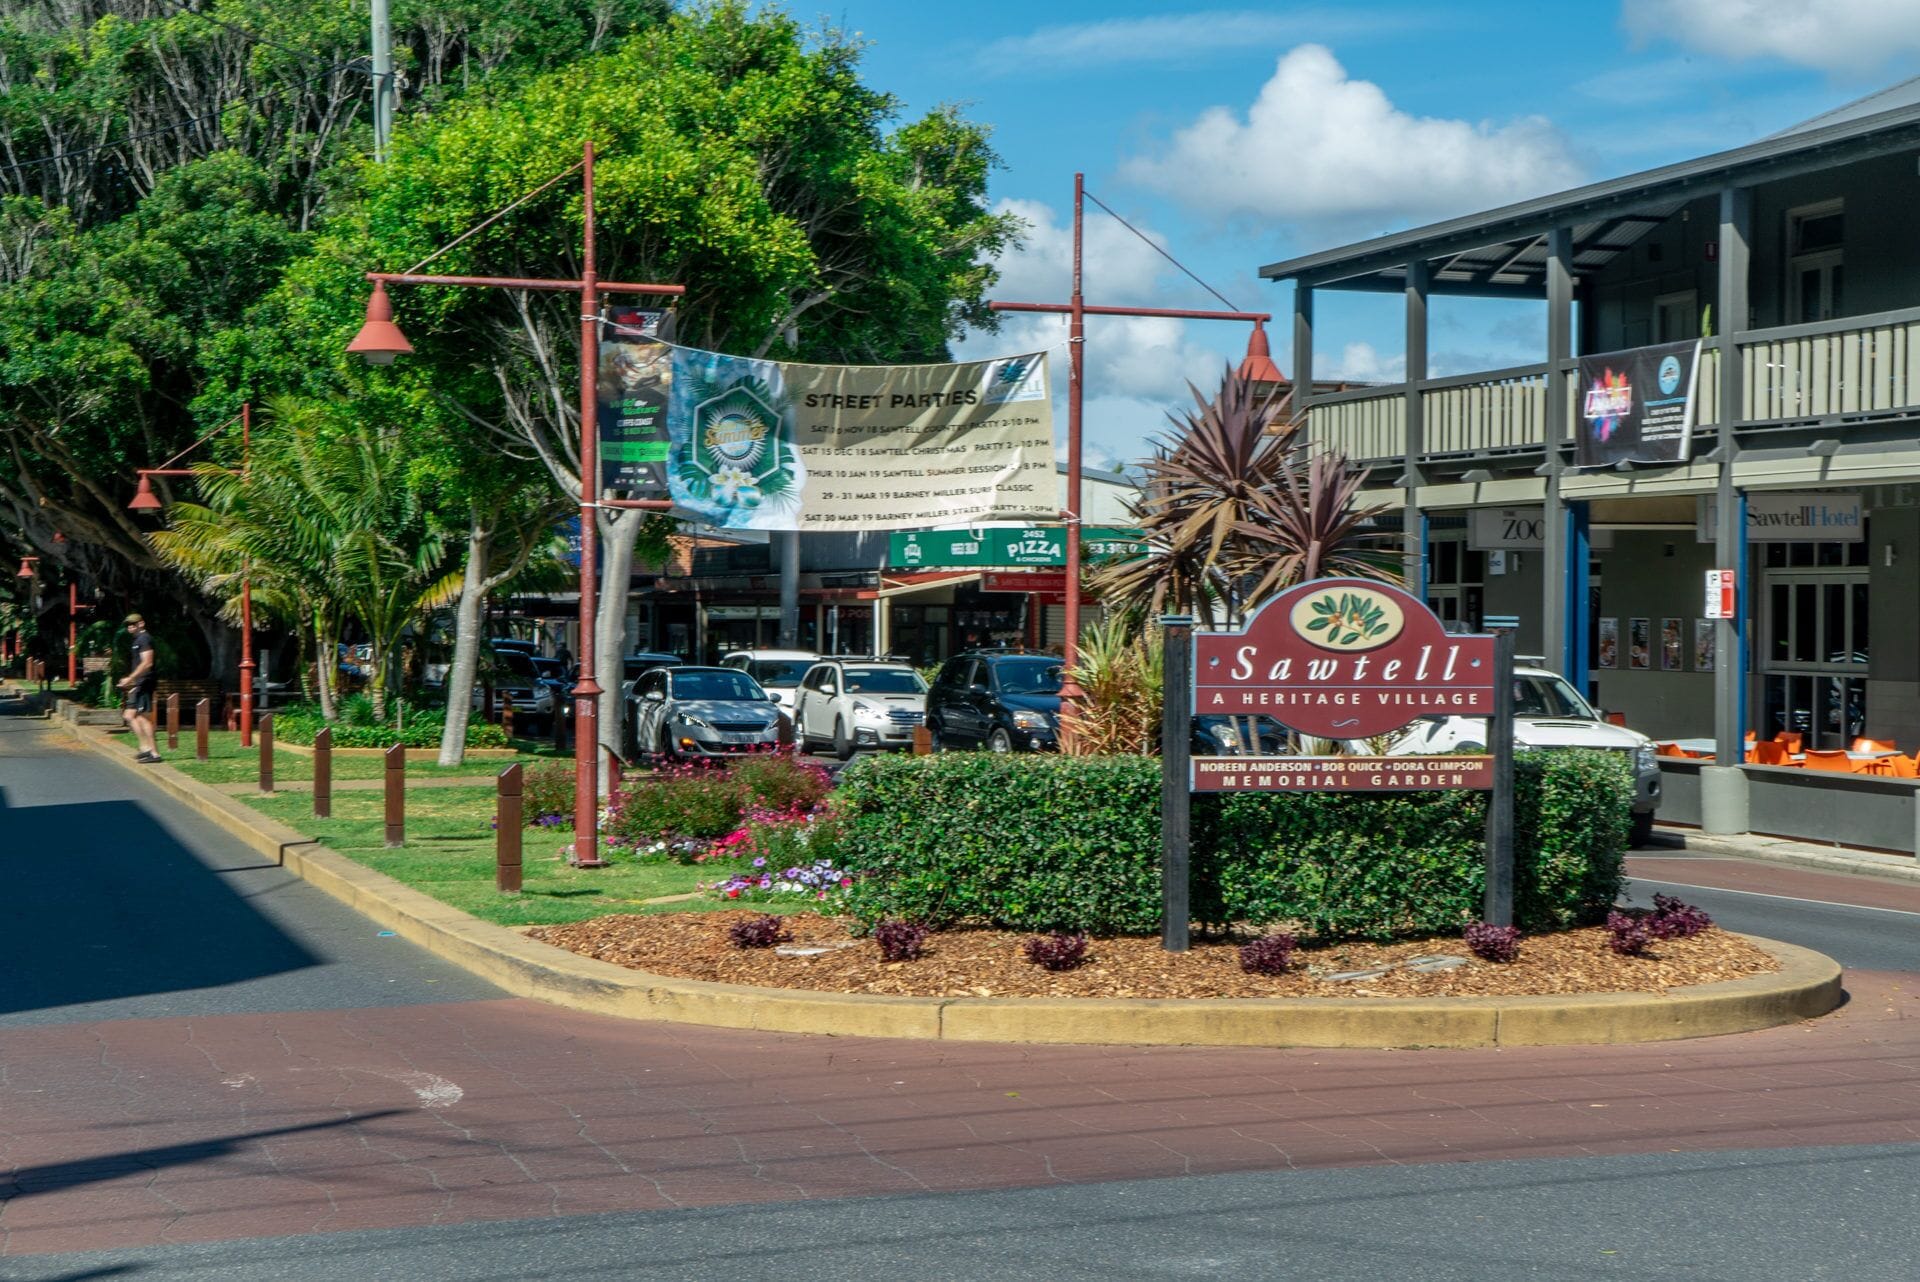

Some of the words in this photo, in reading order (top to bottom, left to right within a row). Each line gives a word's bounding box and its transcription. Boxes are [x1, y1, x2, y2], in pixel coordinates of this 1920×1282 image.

[805, 392, 883, 409] STREET
[890, 388, 977, 408] PARTIES
[811, 424, 829, 433] SAT
[845, 425, 863, 433] NOV
[867, 425, 878, 433] 18
[880, 424, 921, 434] SAWTELL
[970, 420, 999, 430] PARTY
[1002, 417, 1022, 427] 2-10
[1025, 417, 1040, 425] PM
[801, 447, 818, 455] SAT
[821, 447, 831, 456] 15
[834, 447, 853, 456] DEC
[856, 447, 866, 456] 18
[869, 447, 910, 456] SAWTELL
[975, 442, 1004, 452] PARTY
[1007, 441, 1013, 449] 2
[1021, 440, 1032, 448] 10
[1035, 439, 1050, 447] PM
[806, 469, 833, 478] THUR
[836, 469, 846, 478] 10
[848, 469, 866, 478] JAN
[870, 469, 880, 478] 19
[883, 468, 924, 478] SAWTELL
[926, 466, 966, 477] SUMMER
[822, 491, 833, 500] 29
[841, 492, 853, 500] 31
[855, 491, 878, 500] MAR
[880, 491, 890, 500] 19
[893, 490, 930, 499] BARNEY
[933, 488, 966, 497] MILLER
[968, 486, 992, 495] SURF
[995, 484, 1034, 492] CLASSIC
[804, 513, 822, 522] SAT
[825, 513, 836, 522] 30
[838, 513, 859, 521] MAR
[862, 513, 873, 521] 19
[875, 511, 913, 521] BARNEY
[915, 509, 949, 518] MILLER
[1020, 504, 1054, 512] 2-10PM
[1022, 530, 1046, 538] 2452
[1006, 540, 1062, 558] PIZZA
[1231, 644, 1460, 681] Sawtell
[1212, 692, 1225, 705] A
[1242, 692, 1362, 705] HERITAGE
[1378, 692, 1479, 705] VILLAGE
[1200, 762, 1248, 772] NOREEN
[1249, 762, 1312, 772] ANDERSON
[1321, 762, 1346, 772] BOB
[1347, 761, 1384, 772] QUICK
[1392, 761, 1425, 772] DORA
[1427, 761, 1483, 772] CLIMPSON
[1222, 775, 1350, 787] MEMORIAL
[1371, 774, 1463, 786] GARDEN
